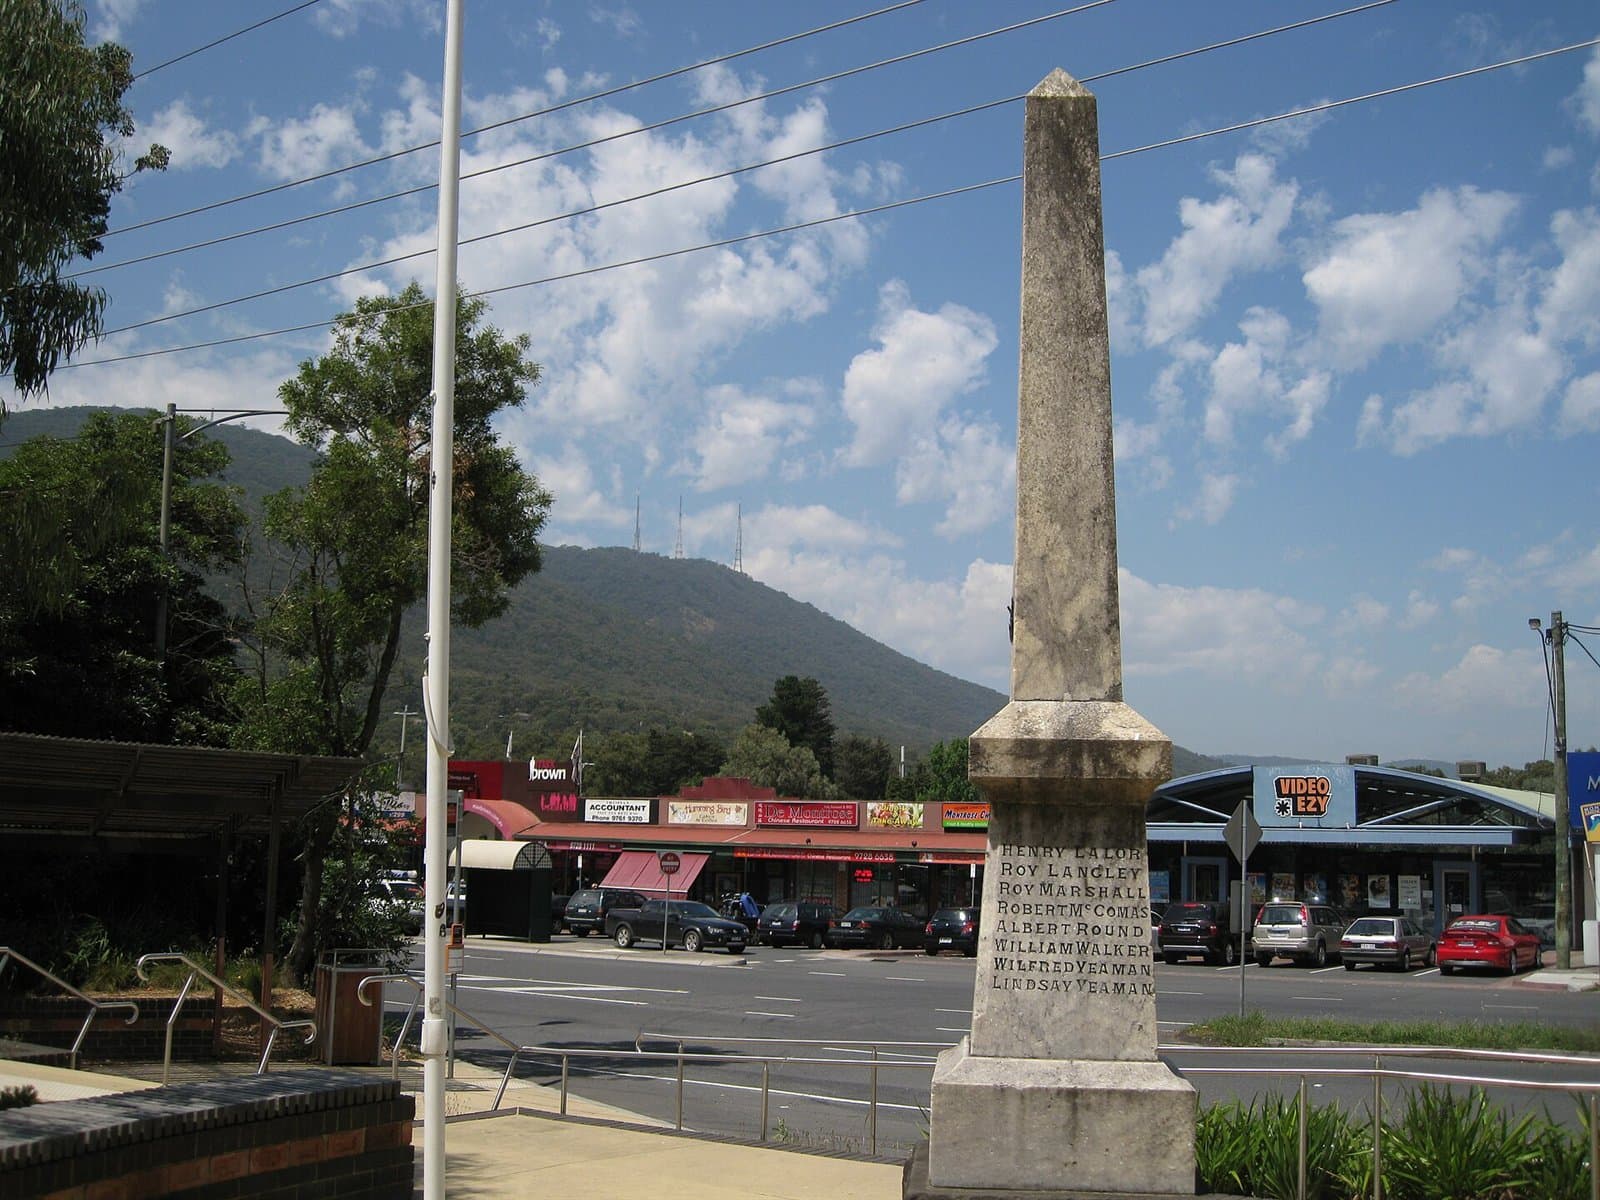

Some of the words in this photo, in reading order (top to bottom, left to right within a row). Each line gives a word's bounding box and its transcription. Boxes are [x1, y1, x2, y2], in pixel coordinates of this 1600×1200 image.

[529, 757, 566, 780] brown
[1280, 778, 1329, 795] VIDEO
[589, 804, 647, 812] ACCOUNTANT
[764, 804, 785, 818] De
[787, 804, 854, 819] Montrose
[1297, 795, 1328, 812] EZY
[854, 852, 873, 860] 9728
[1002, 843, 1065, 858] HENRY
[1075, 848, 1141, 860] LALOR
[1001, 862, 1039, 877] ROY
[1048, 863, 1142, 880] LANGLEY
[999, 882, 1035, 895] ROY
[1039, 882, 1146, 899] MARSHALL
[997, 901, 1068, 917] ROBERT
[996, 919, 1072, 935] ALBERT
[1076, 922, 1144, 938] ROUND
[995, 938, 1073, 955] WILLIAM
[1076, 941, 1149, 957] WALKER
[994, 957, 1074, 973] WILFRED
[1076, 960, 1151, 976] YEAMAN
[992, 975, 1072, 992] LINDSAY
[1076, 978, 1154, 996] YEAMAN
